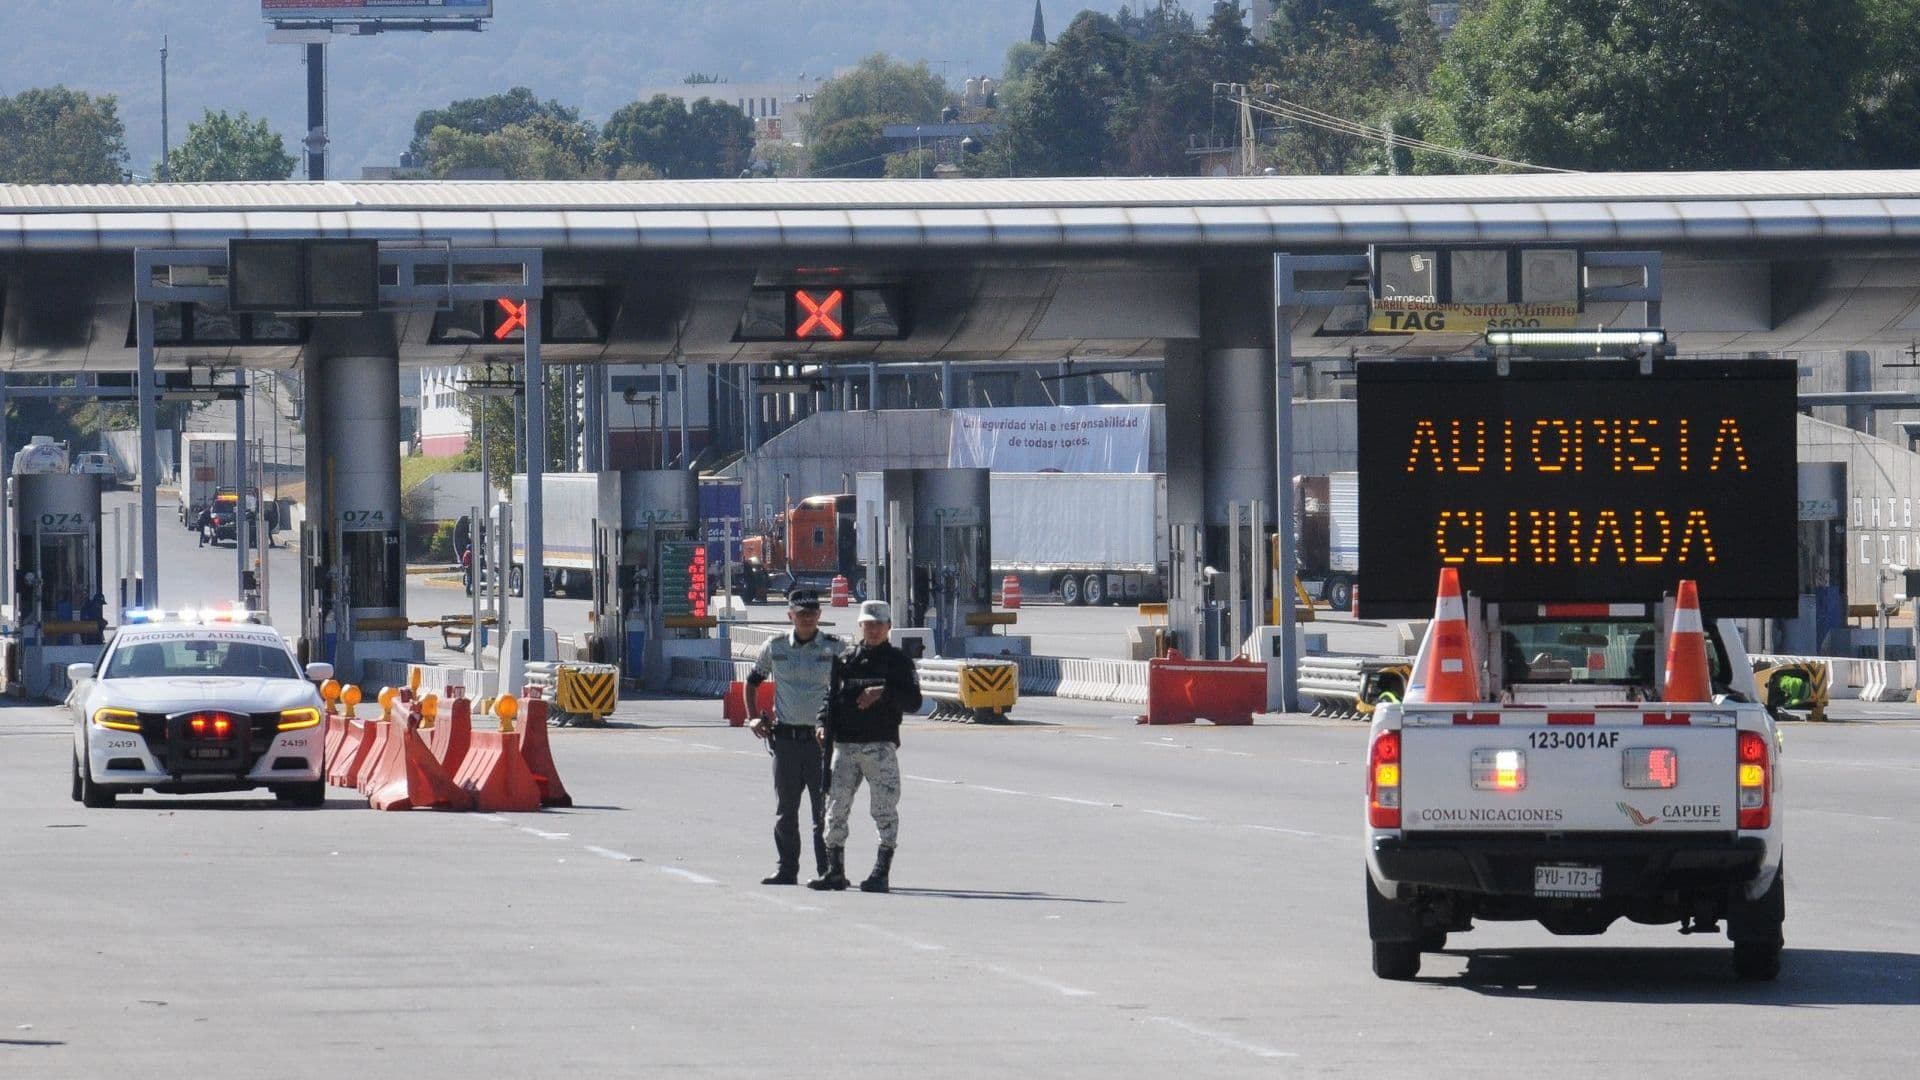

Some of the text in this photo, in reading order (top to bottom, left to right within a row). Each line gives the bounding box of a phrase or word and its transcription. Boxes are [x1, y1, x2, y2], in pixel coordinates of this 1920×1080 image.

[1375, 302, 1460, 311] ARRIL EXCLUSIVO
[1463, 303, 1507, 317] Saldo
[1385, 311, 1445, 330] TAG
[1486, 318, 1541, 328] $600
[979, 416, 1026, 432] eguridad
[1029, 419, 1048, 432] vial
[1008, 436, 1021, 447] de
[41, 513, 82, 525] 074
[343, 510, 385, 522] 074
[108, 740, 137, 748] 24191
[280, 739, 308, 747] 24191
[1528, 731, 1619, 749] 123-001AF
[1422, 808, 1563, 821] COMUNICACIONES
[1662, 804, 1721, 817] CAPUFE
